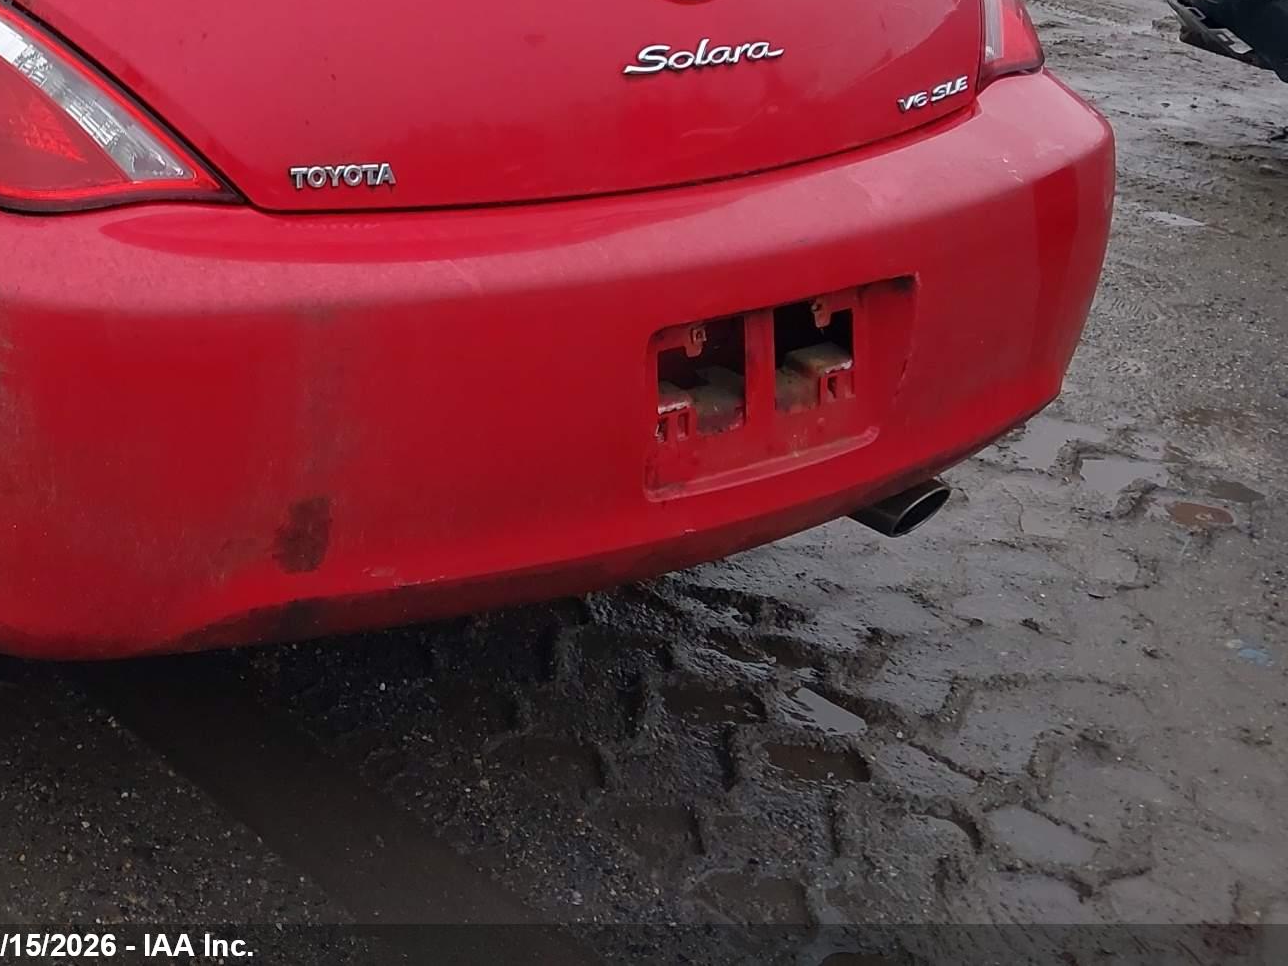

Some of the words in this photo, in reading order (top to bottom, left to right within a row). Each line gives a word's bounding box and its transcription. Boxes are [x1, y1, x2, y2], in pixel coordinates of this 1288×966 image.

[623, 38, 785, 74] Solara
[931, 75, 968, 102] SLE
[290, 163, 397, 189] TOYOTA
